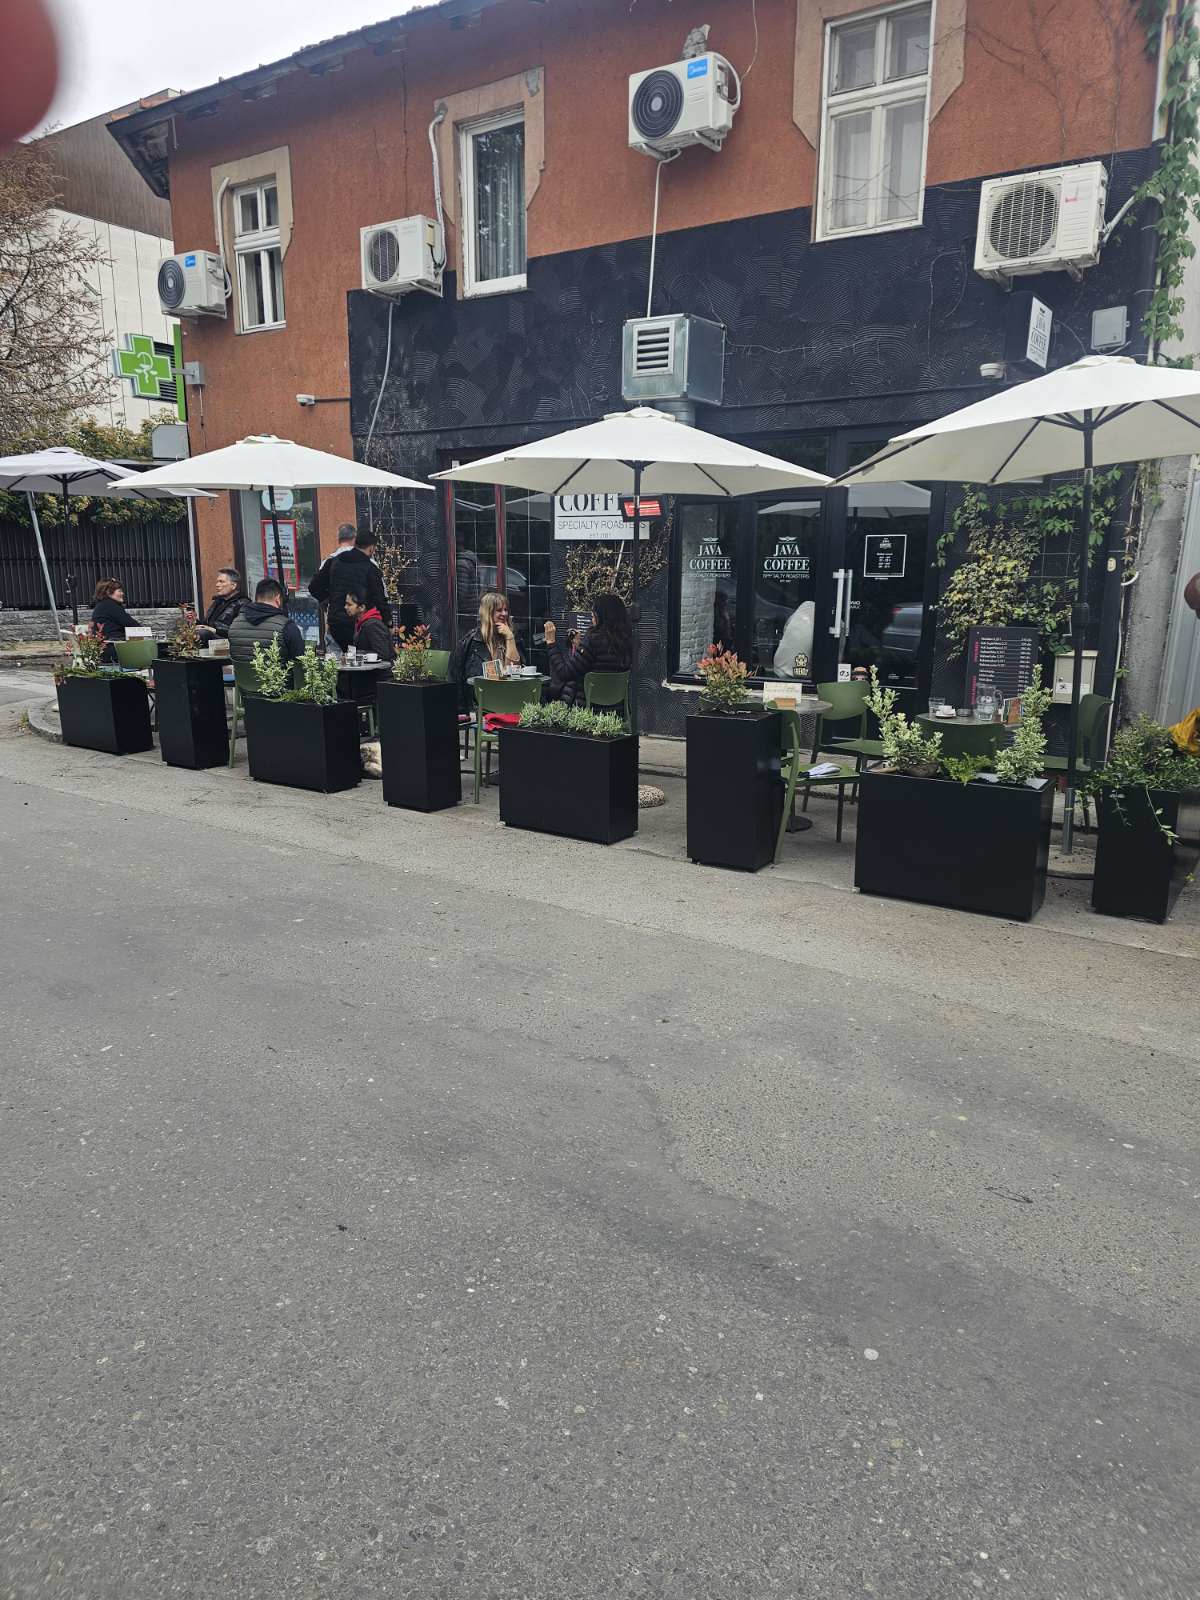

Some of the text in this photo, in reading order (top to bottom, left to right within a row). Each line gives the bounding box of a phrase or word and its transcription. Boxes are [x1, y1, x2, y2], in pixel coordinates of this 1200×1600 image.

[559, 493, 622, 511] COFF
[558, 520, 647, 530] SPECIALTY ROASTES
[698, 544, 722, 557] JAVA
[773, 544, 800, 557] JAVA
[689, 559, 732, 570] COFFEE
[763, 559, 810, 571] COFFEE
